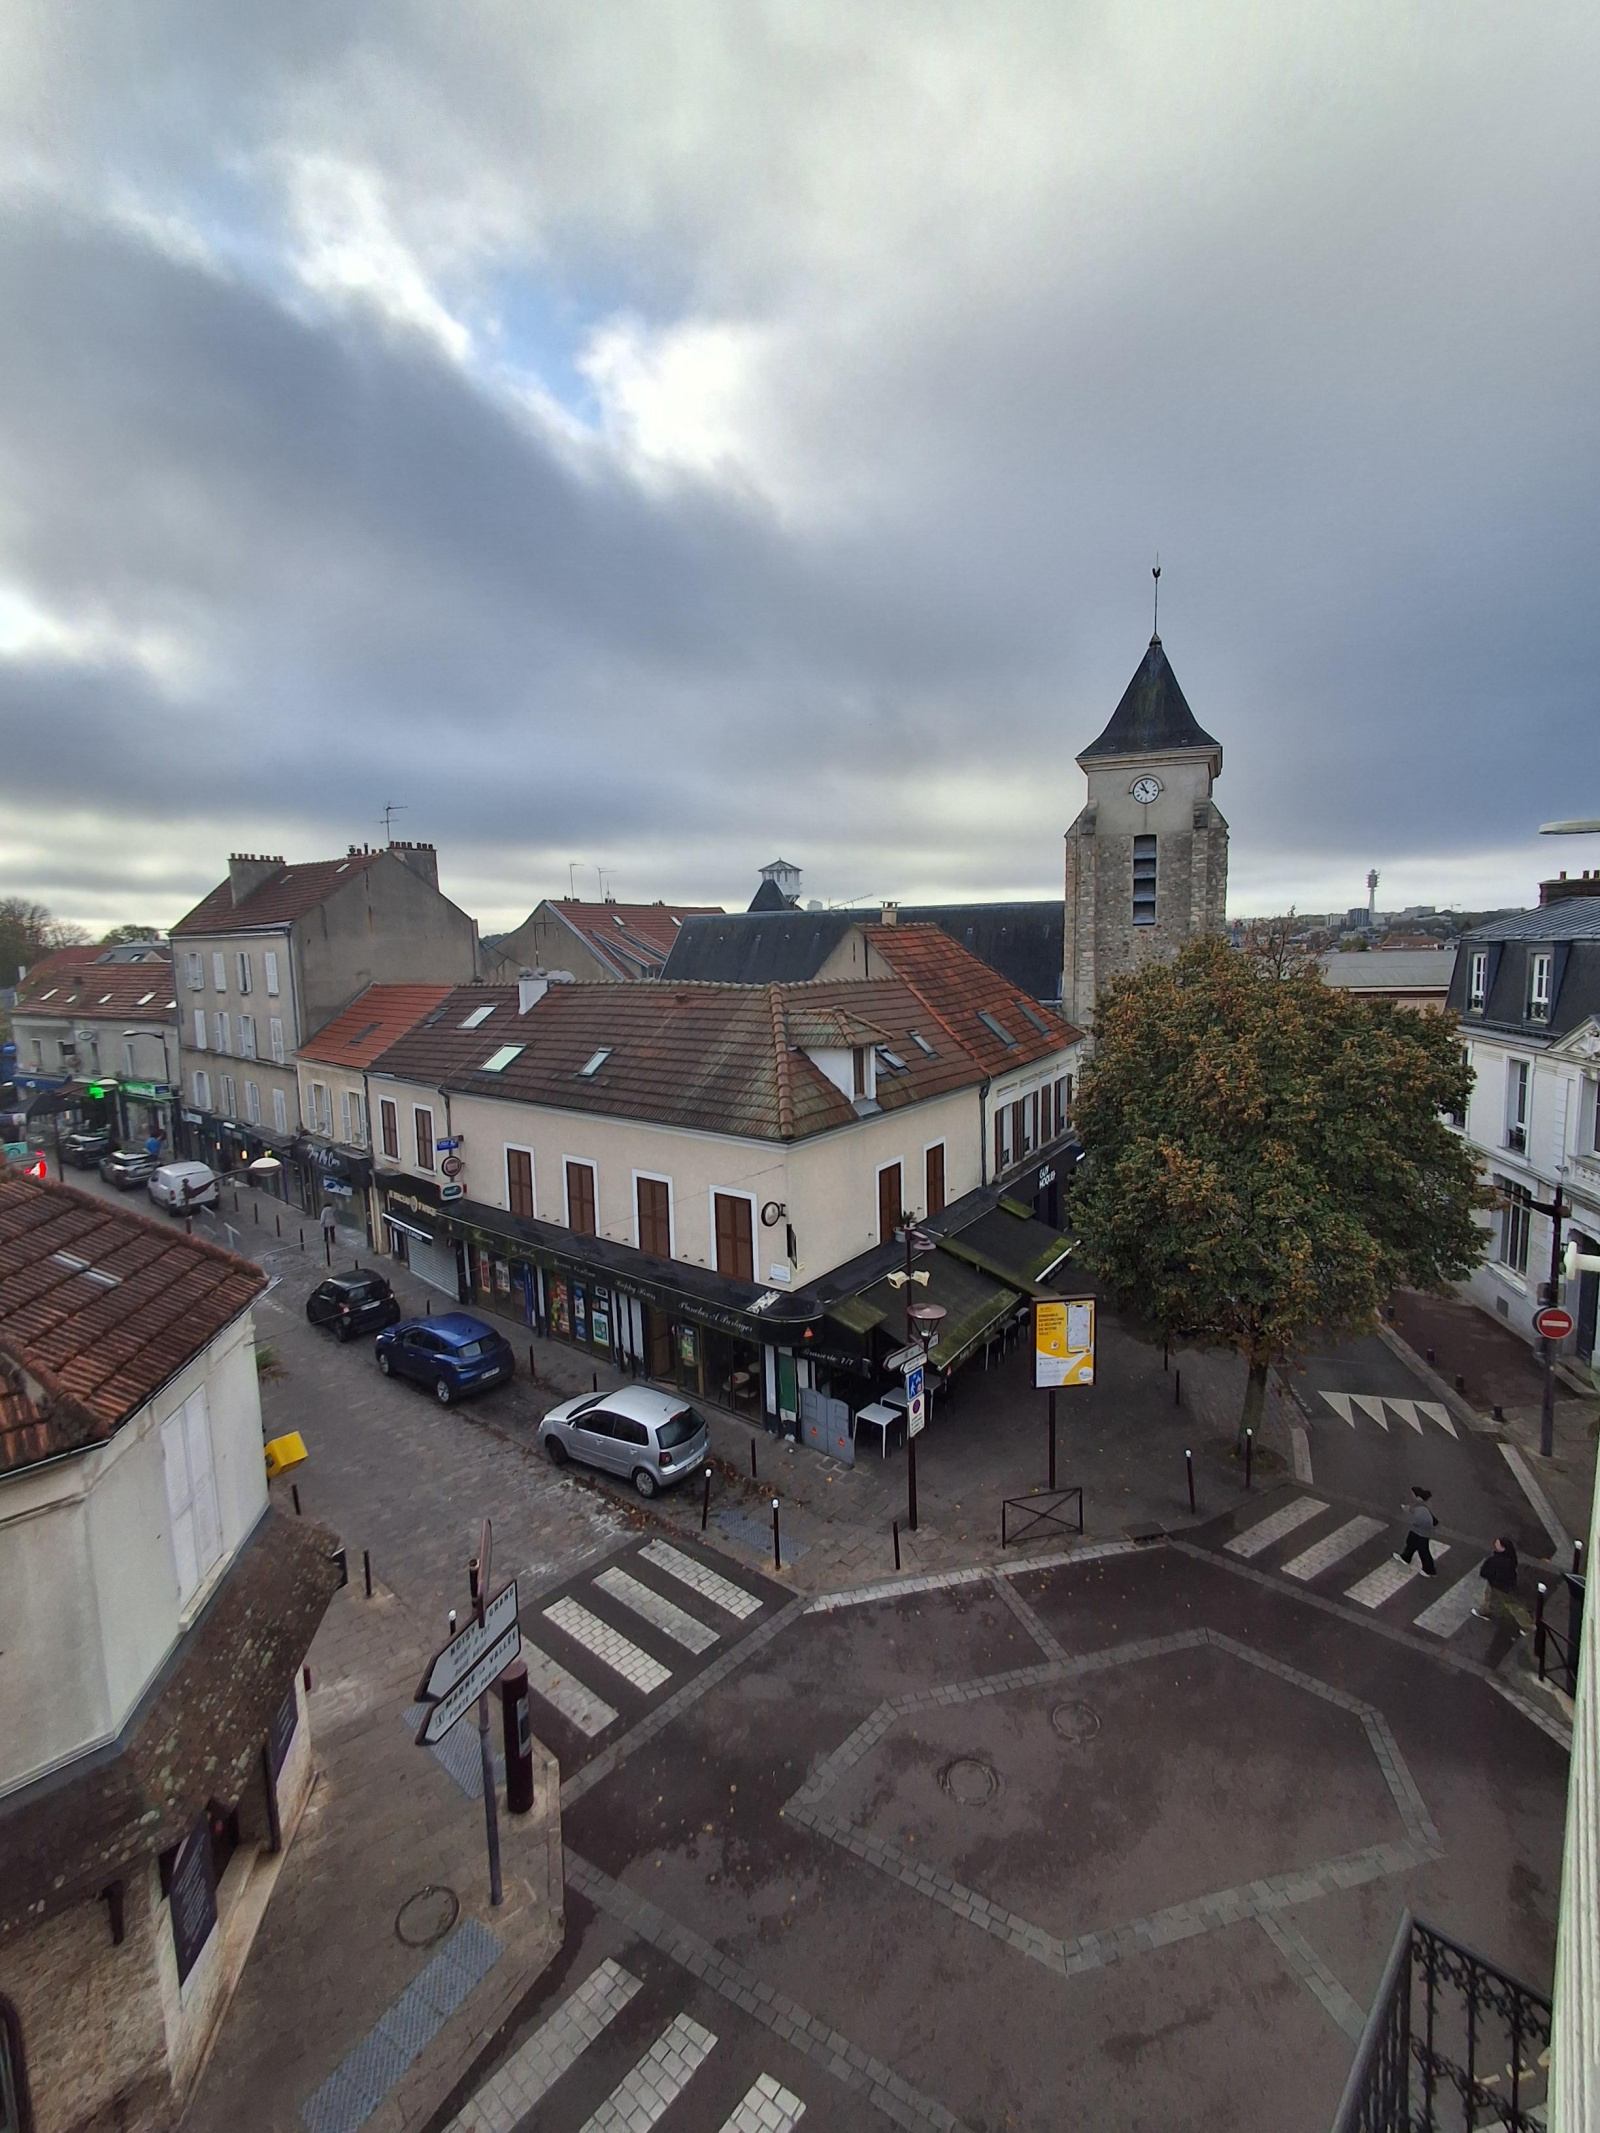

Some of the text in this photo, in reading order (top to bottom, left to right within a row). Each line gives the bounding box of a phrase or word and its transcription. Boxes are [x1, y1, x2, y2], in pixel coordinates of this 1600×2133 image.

[1039, 1164, 1049, 1179] GUY
[678, 1301, 708, 1318] Planches
[451, 1587, 514, 1657] NOISY GRAND
[446, 1674, 476, 1710] MARNE
